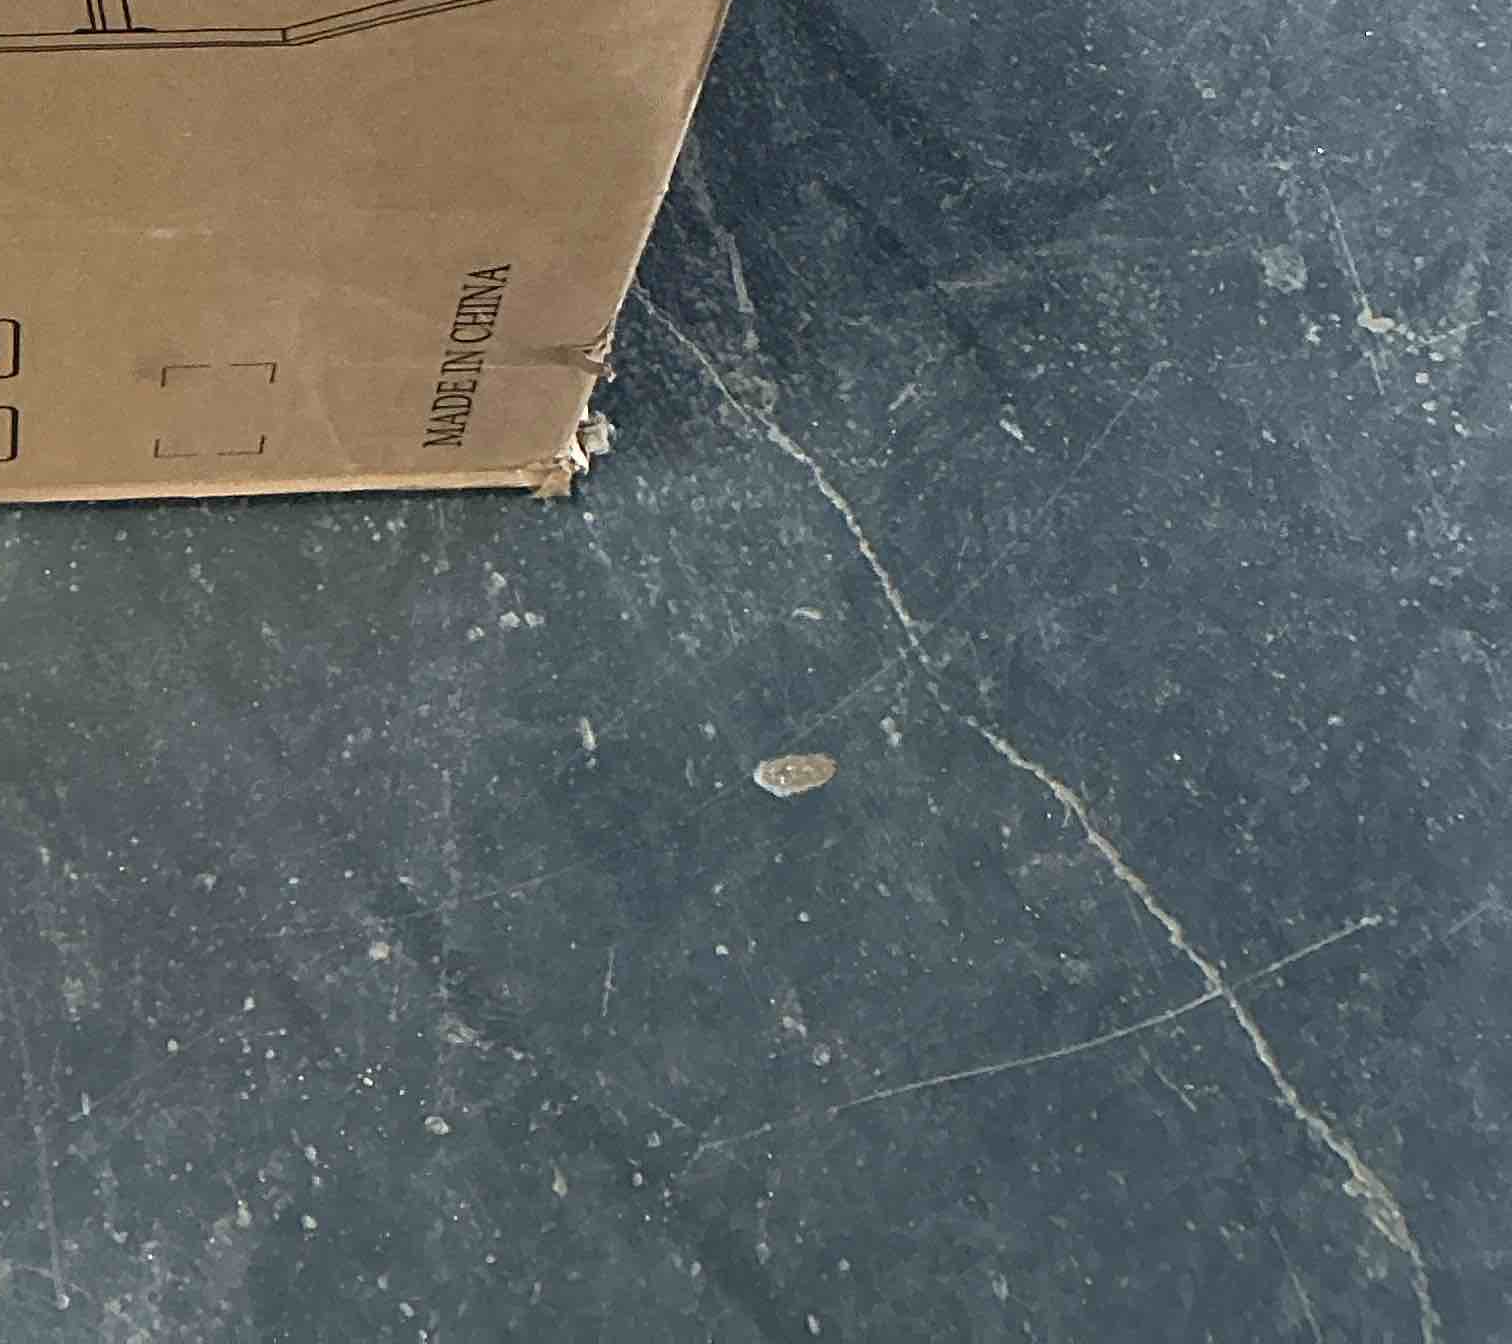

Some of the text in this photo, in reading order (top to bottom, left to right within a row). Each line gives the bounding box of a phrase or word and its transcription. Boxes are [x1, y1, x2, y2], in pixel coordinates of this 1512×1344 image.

[421, 263, 512, 449] MADE IN CHINA
